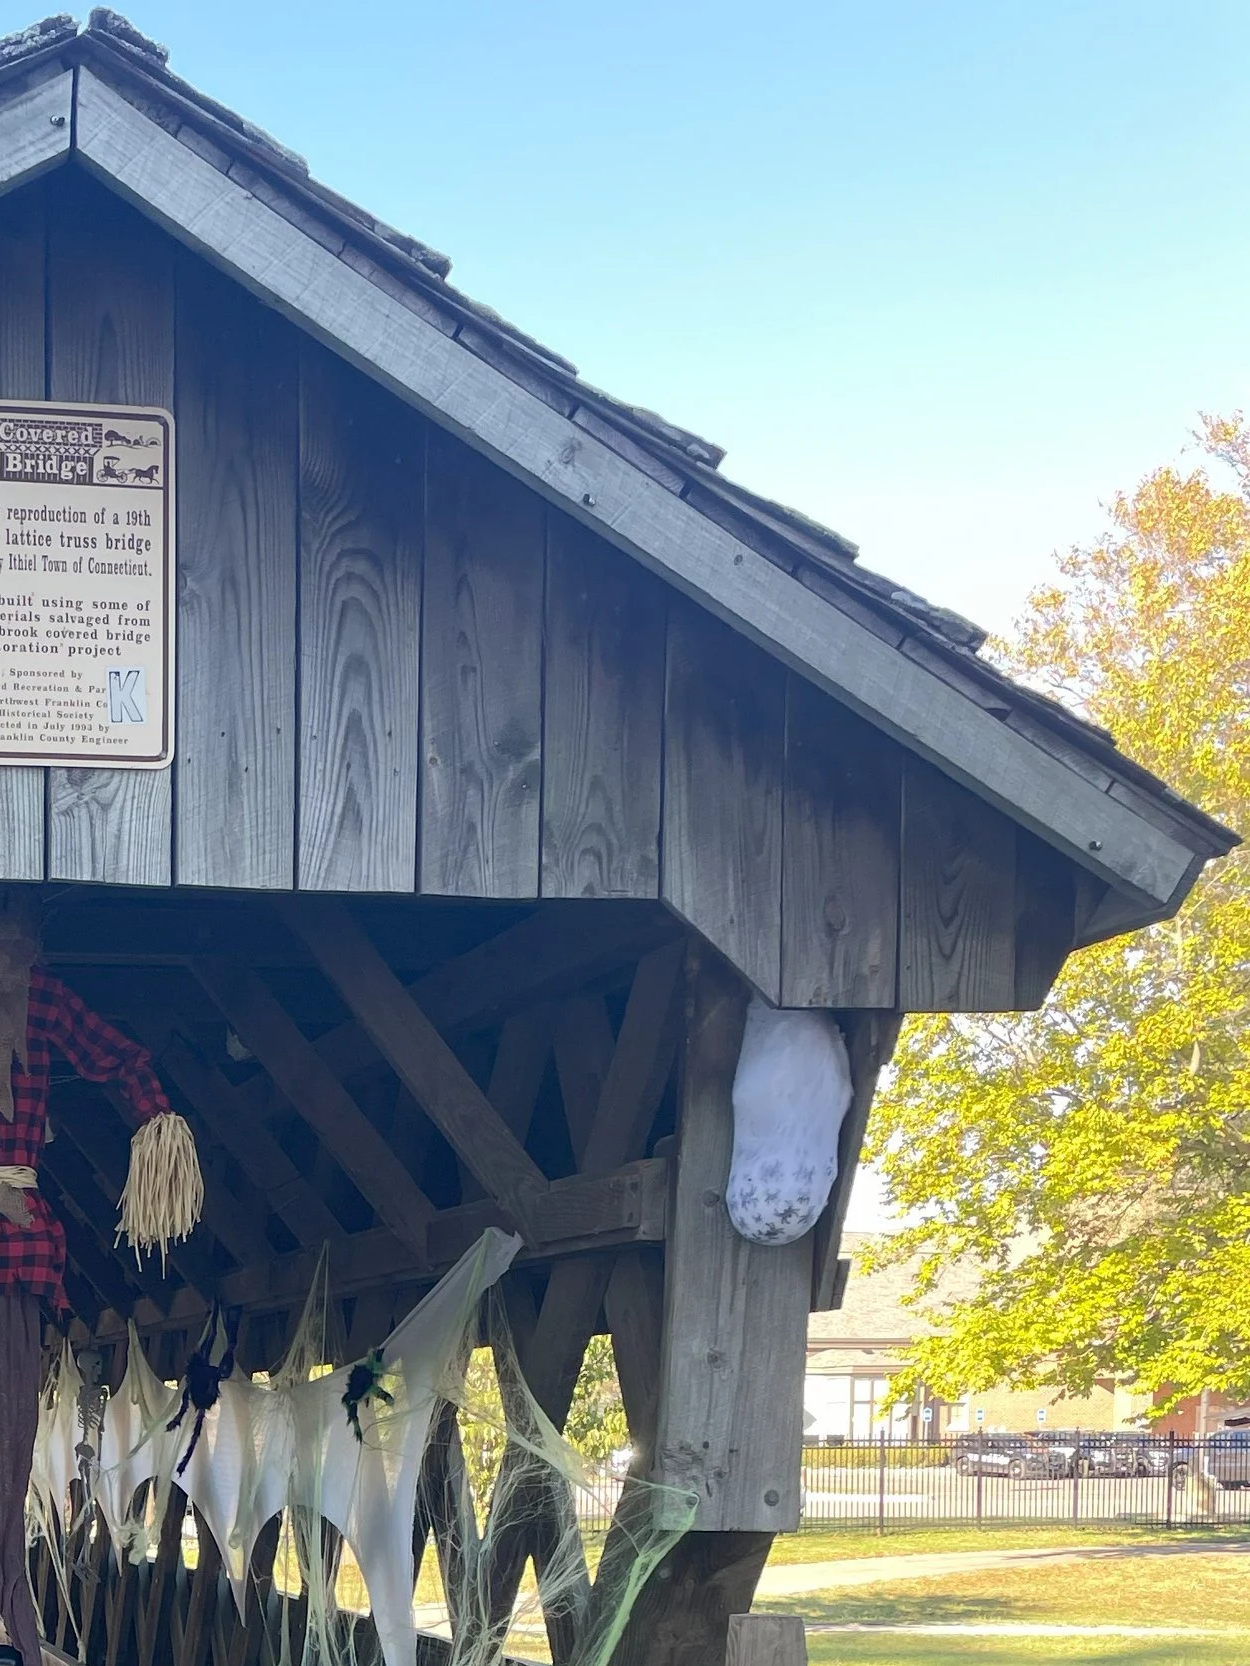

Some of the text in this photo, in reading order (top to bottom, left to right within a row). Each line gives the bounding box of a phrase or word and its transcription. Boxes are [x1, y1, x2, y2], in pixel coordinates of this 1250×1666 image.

[0, 422, 94, 444] Covered
[6, 455, 87, 479] Bridge
[7, 505, 86, 524] reproduction
[94, 508, 106, 524] of
[113, 512, 119, 524] a
[126, 510, 150, 526] 19th
[6, 529, 51, 547] lattice
[60, 532, 97, 549] truss
[106, 533, 151, 554] bridge
[9, 555, 36, 571] Ithiel
[42, 556, 67, 572] Town
[73, 556, 83, 573] of
[88, 557, 152, 576] Connecticut.
[42, 597, 83, 611] using
[93, 601, 127, 610] some
[137, 600, 150, 611] of
[50, 613, 109, 626] salvaged
[118, 615, 150, 626] from
[46, 629, 97, 639] covered
[107, 629, 150, 643] bridge
[68, 645, 121, 658] project
[10, 668, 82, 679] Sponsored by
[14, 683, 69, 692] Recreation
[109, 670, 143, 722] K
[45, 699, 90, 707] Franklin
[0, 709, 94, 720] Historical Society
[43, 722, 65, 732] July
[99, 724, 110, 733] by
[40, 734, 75, 744] County
[82, 735, 128, 745] Engineer
